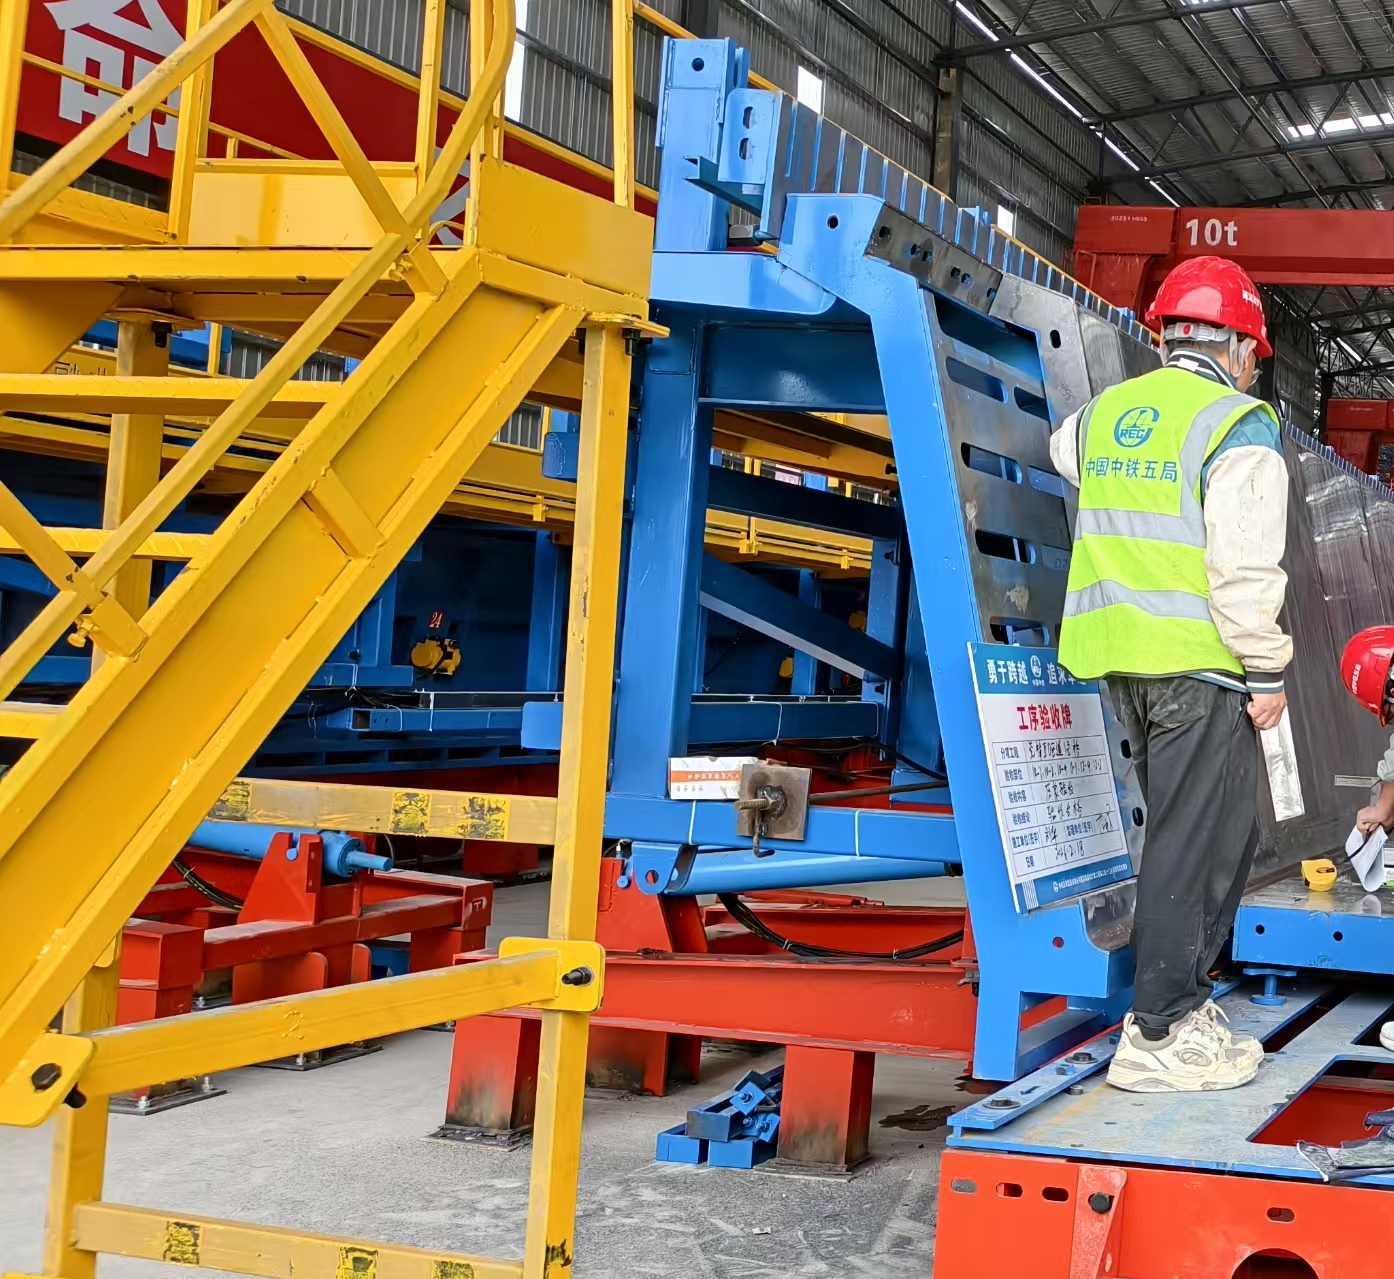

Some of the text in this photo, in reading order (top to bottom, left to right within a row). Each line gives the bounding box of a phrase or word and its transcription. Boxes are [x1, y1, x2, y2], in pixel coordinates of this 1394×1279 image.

[1186, 218, 1237, 246] 10t
[1086, 457, 1177, 482] 中国中铁五局
[987, 659, 1029, 685] 勇于跨越
[1016, 703, 1073, 732] 工序验收牌
